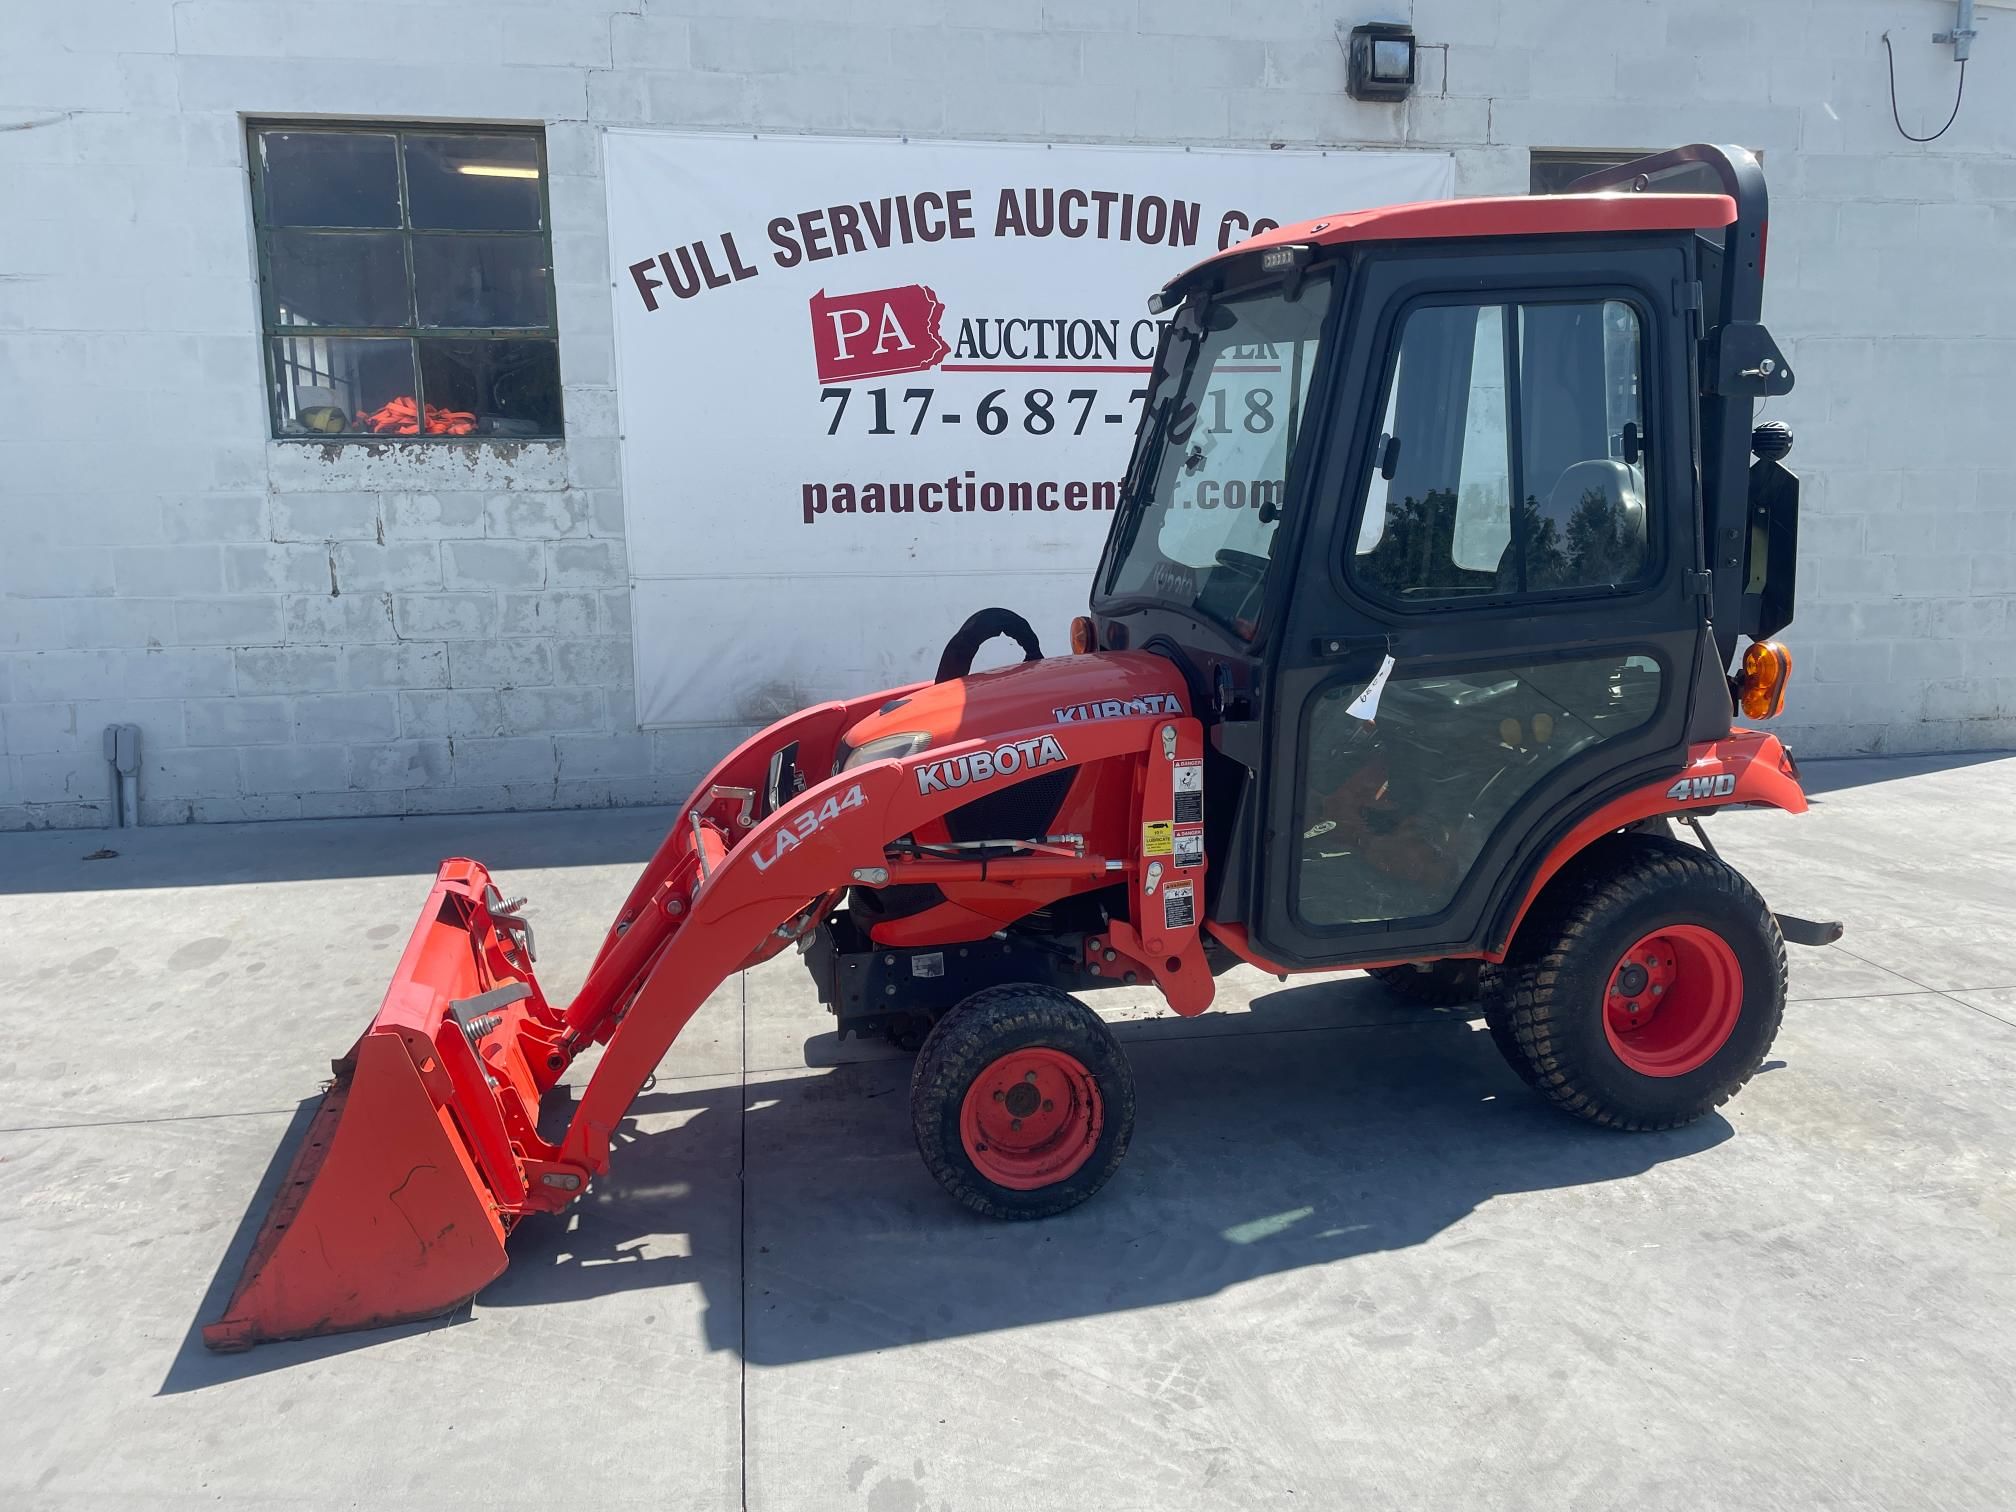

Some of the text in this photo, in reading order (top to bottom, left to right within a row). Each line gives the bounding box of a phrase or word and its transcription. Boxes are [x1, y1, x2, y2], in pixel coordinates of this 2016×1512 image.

[629, 231, 759, 312] FULL
[767, 190, 976, 268] SERVICE
[994, 187, 1201, 247] AUCTION
[826, 302, 916, 361] PA
[953, 318, 1120, 360] AUCTION
[819, 387, 1275, 436] 717-687-18
[802, 470, 1286, 524] paauctioncen.com
[1054, 693, 1184, 723] KUBOTA
[914, 734, 1068, 796] KUBOTA
[1666, 773, 1736, 801] 4WD
[751, 783, 867, 872] LA344
